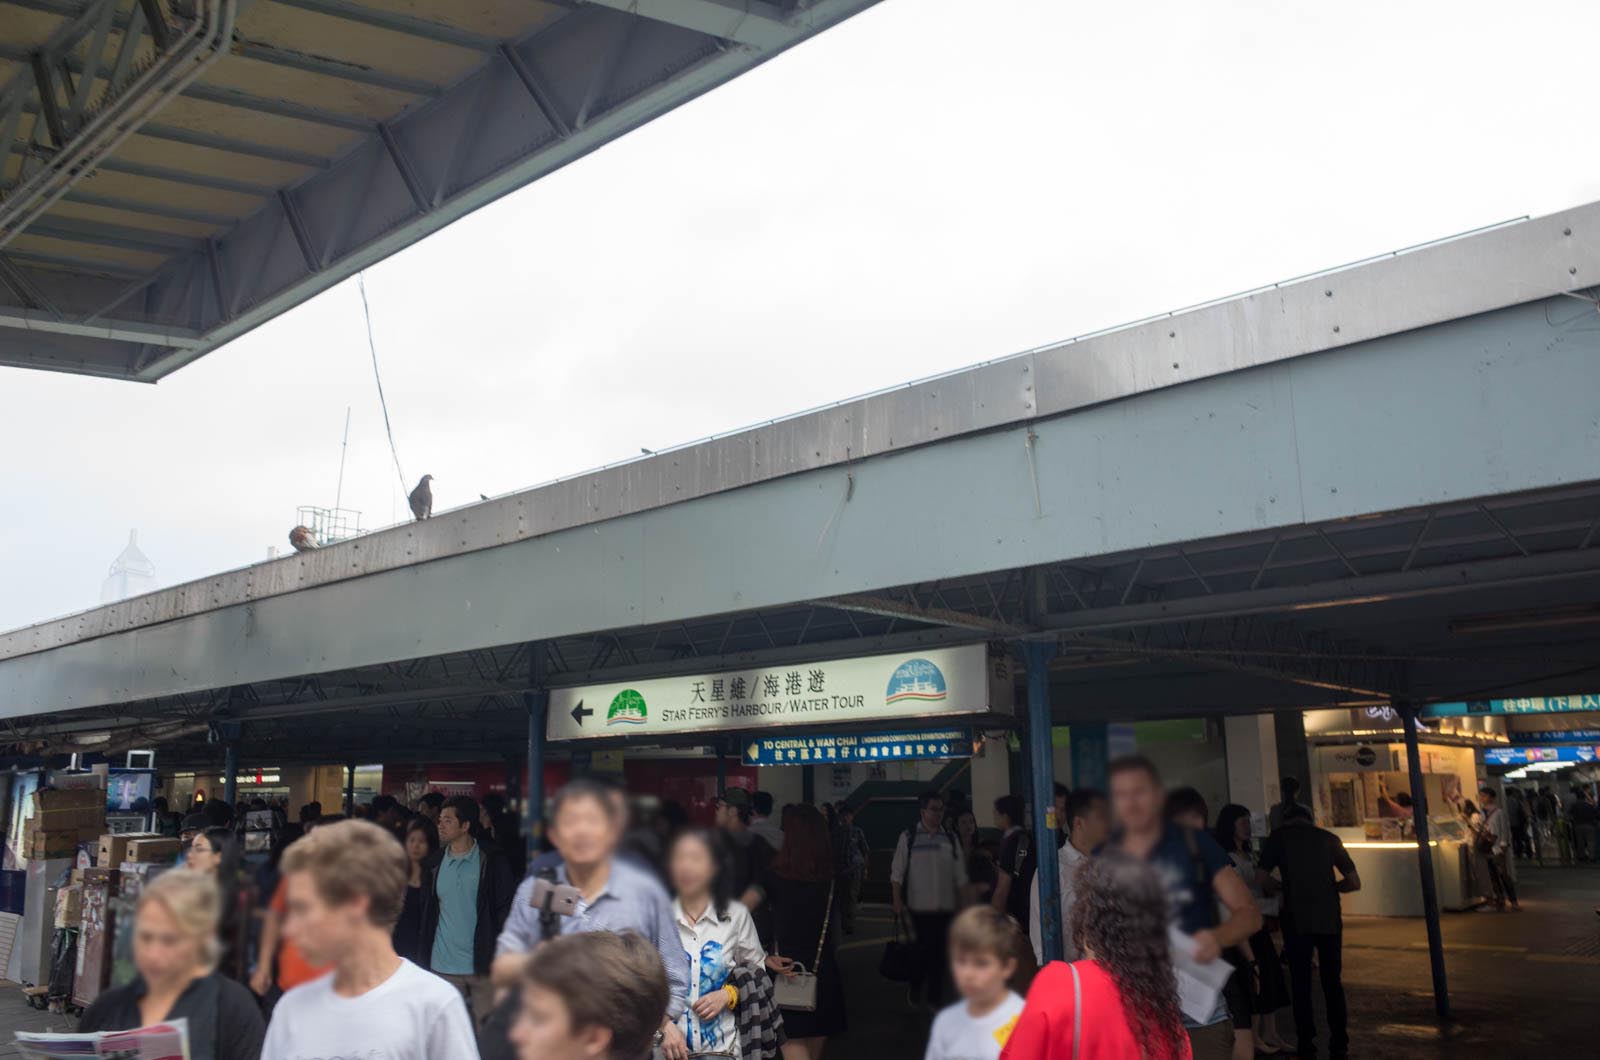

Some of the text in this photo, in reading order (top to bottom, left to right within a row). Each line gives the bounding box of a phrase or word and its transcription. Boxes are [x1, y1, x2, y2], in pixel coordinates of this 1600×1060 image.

[690, 668, 826, 704] 天星維/海港遊
[661, 709, 687, 722] STAR
[688, 706, 729, 720] FERRY'S
[831, 695, 865, 710] TOUR
[763, 740, 774, 750] TO
[774, 739, 808, 749] CENTRAL
[815, 738, 835, 747] WAN
[836, 736, 858, 746] CHAI
